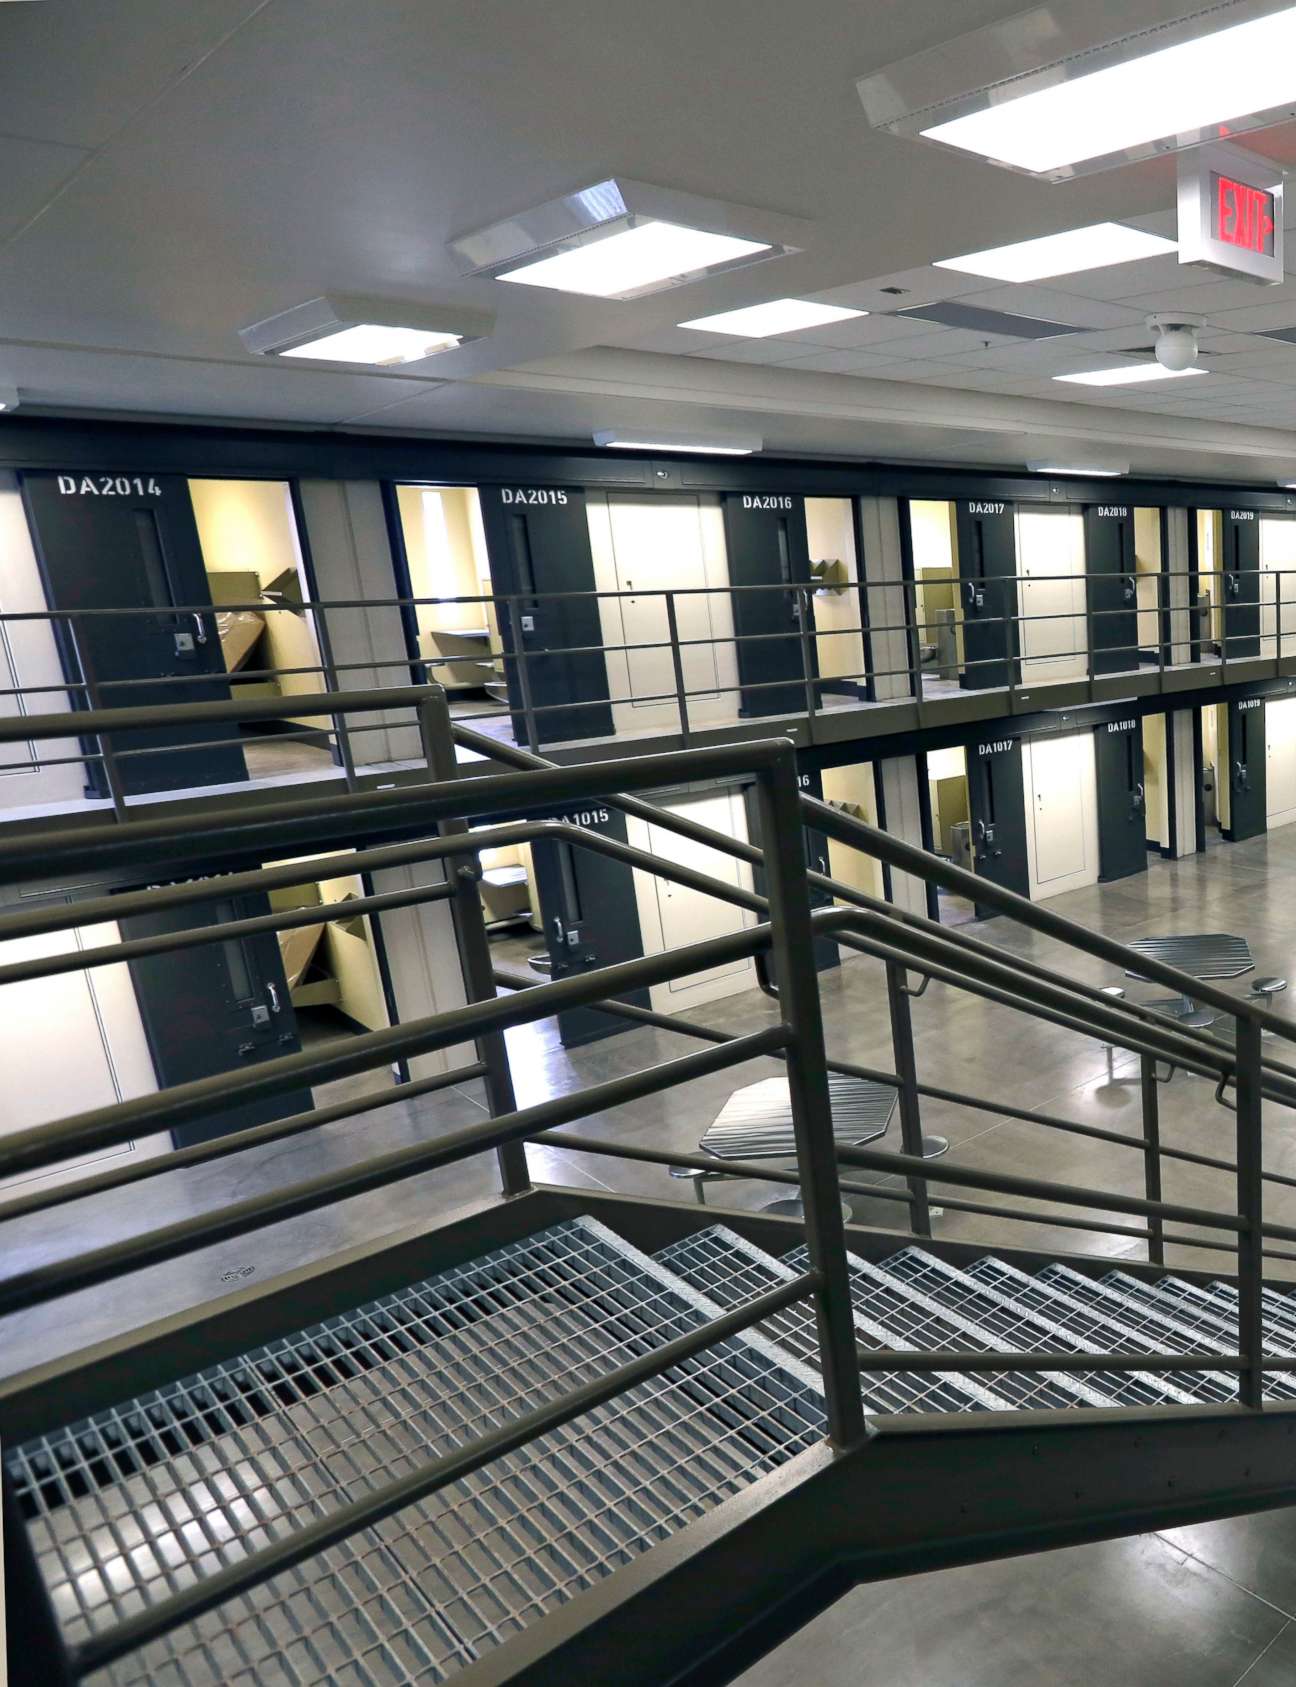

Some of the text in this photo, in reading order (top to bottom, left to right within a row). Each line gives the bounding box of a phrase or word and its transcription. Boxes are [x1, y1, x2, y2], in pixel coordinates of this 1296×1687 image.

[1218, 176, 1268, 254] EXIT
[58, 476, 161, 496] DA2014
[502, 488, 567, 504] DA2015
[743, 495, 791, 509] DA2016
[969, 502, 1005, 515] DA2017
[1098, 506, 1128, 517] DA2018
[1231, 510, 1255, 521] DA2019
[1107, 719, 1136, 733] DA1018
[979, 739, 1013, 756] DA1017
